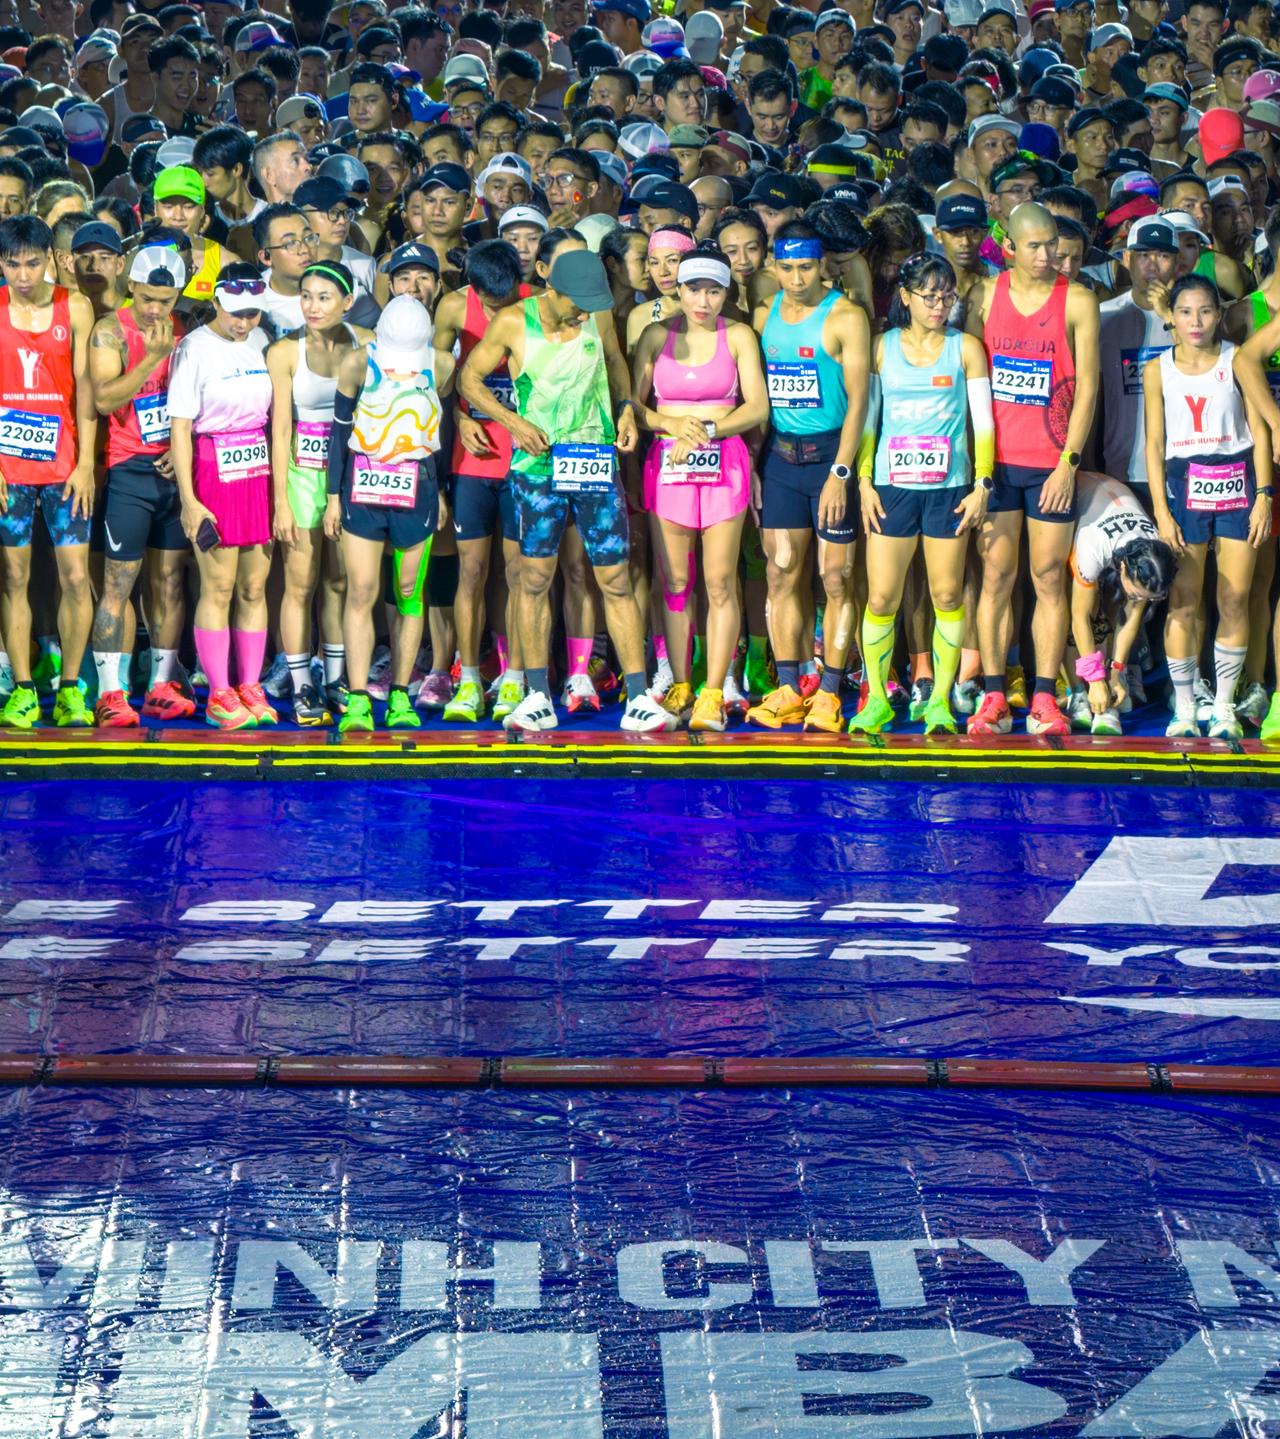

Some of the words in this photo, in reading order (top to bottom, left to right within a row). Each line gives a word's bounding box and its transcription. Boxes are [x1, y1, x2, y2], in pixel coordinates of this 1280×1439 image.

[771, 378, 817, 392] 21337
[996, 371, 1046, 390] 22241
[1, 424, 55, 444] 22084
[301, 438, 329, 453] 203
[221, 446, 267, 465] 20398
[894, 452, 945, 467] 20061
[558, 462, 611, 476] 21504
[359, 473, 412, 490] 20455
[1193, 478, 1243, 494] 20490
[178, 898, 961, 924] BETTER
[171, 935, 972, 962] BETTER
[616, 1238, 1108, 1310] CITY
